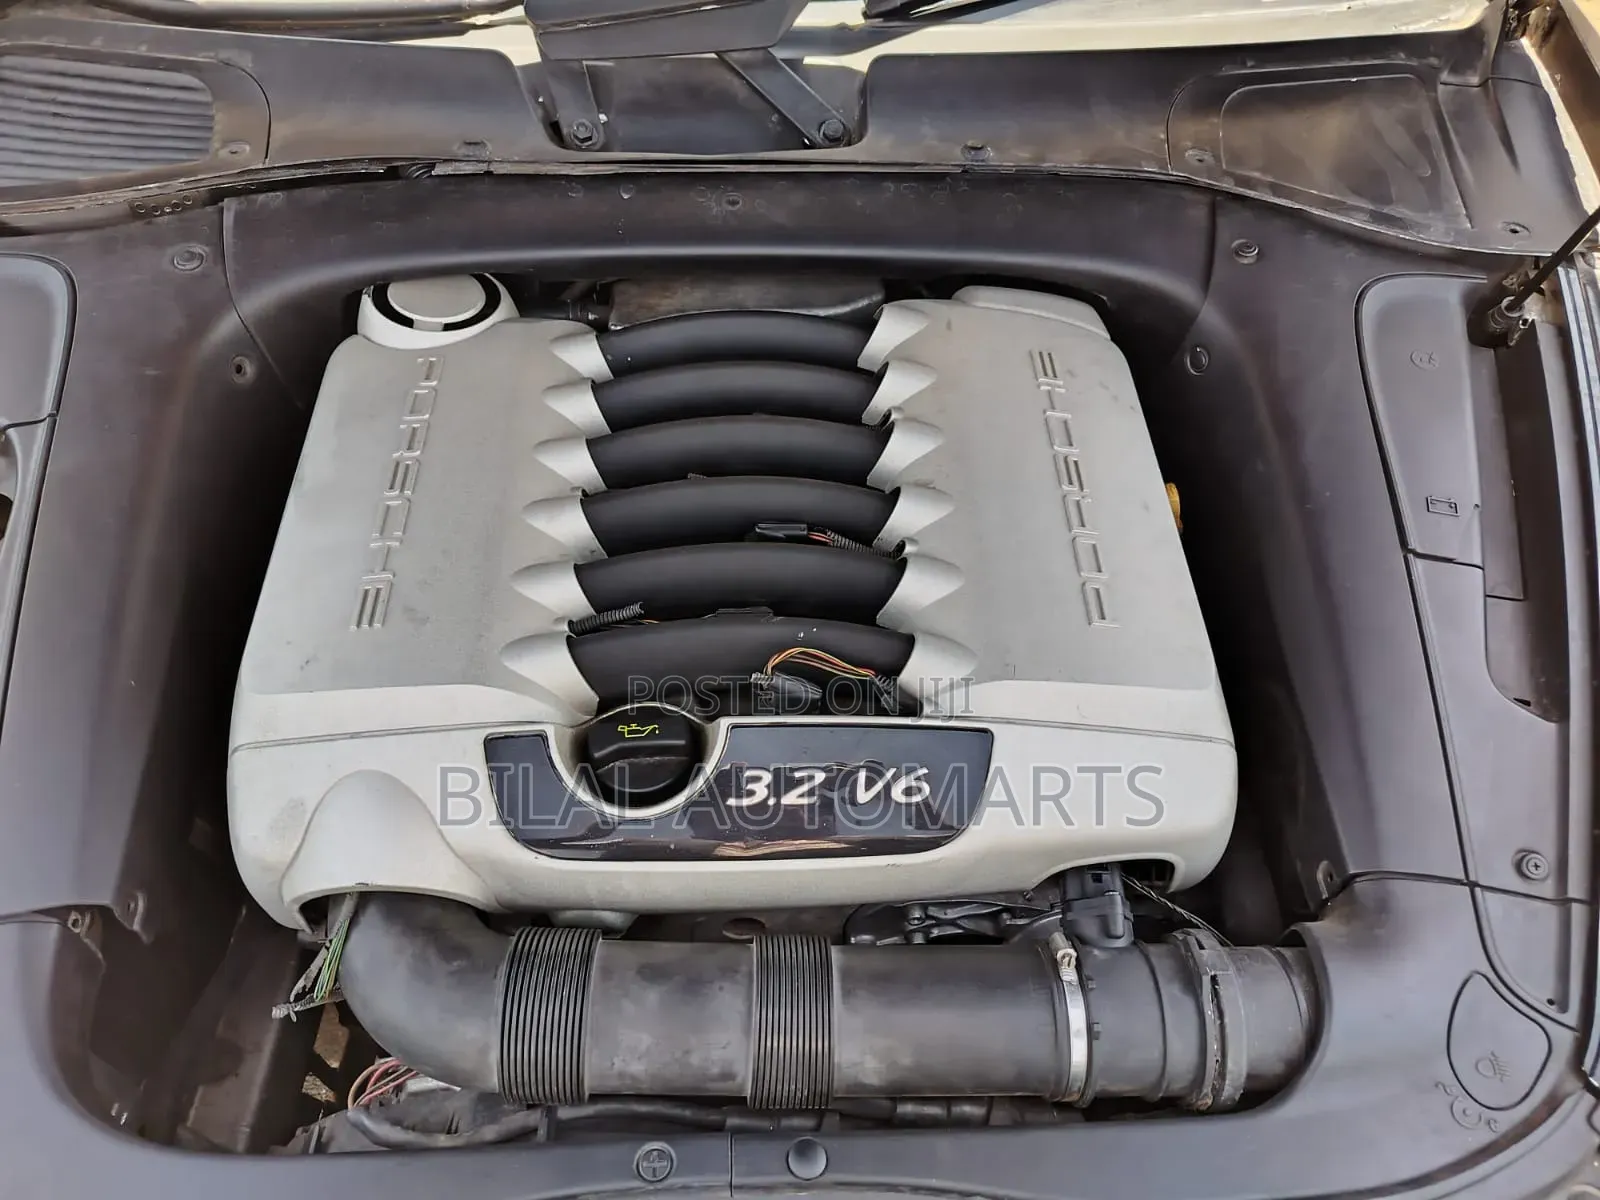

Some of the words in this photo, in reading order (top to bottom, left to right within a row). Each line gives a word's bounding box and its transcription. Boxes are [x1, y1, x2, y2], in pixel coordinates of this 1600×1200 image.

[349, 355, 444, 632] PORSCHE
[1029, 349, 1122, 629] PORSCHE
[725, 767, 827, 807] 3.2
[856, 766, 931, 805] V6
